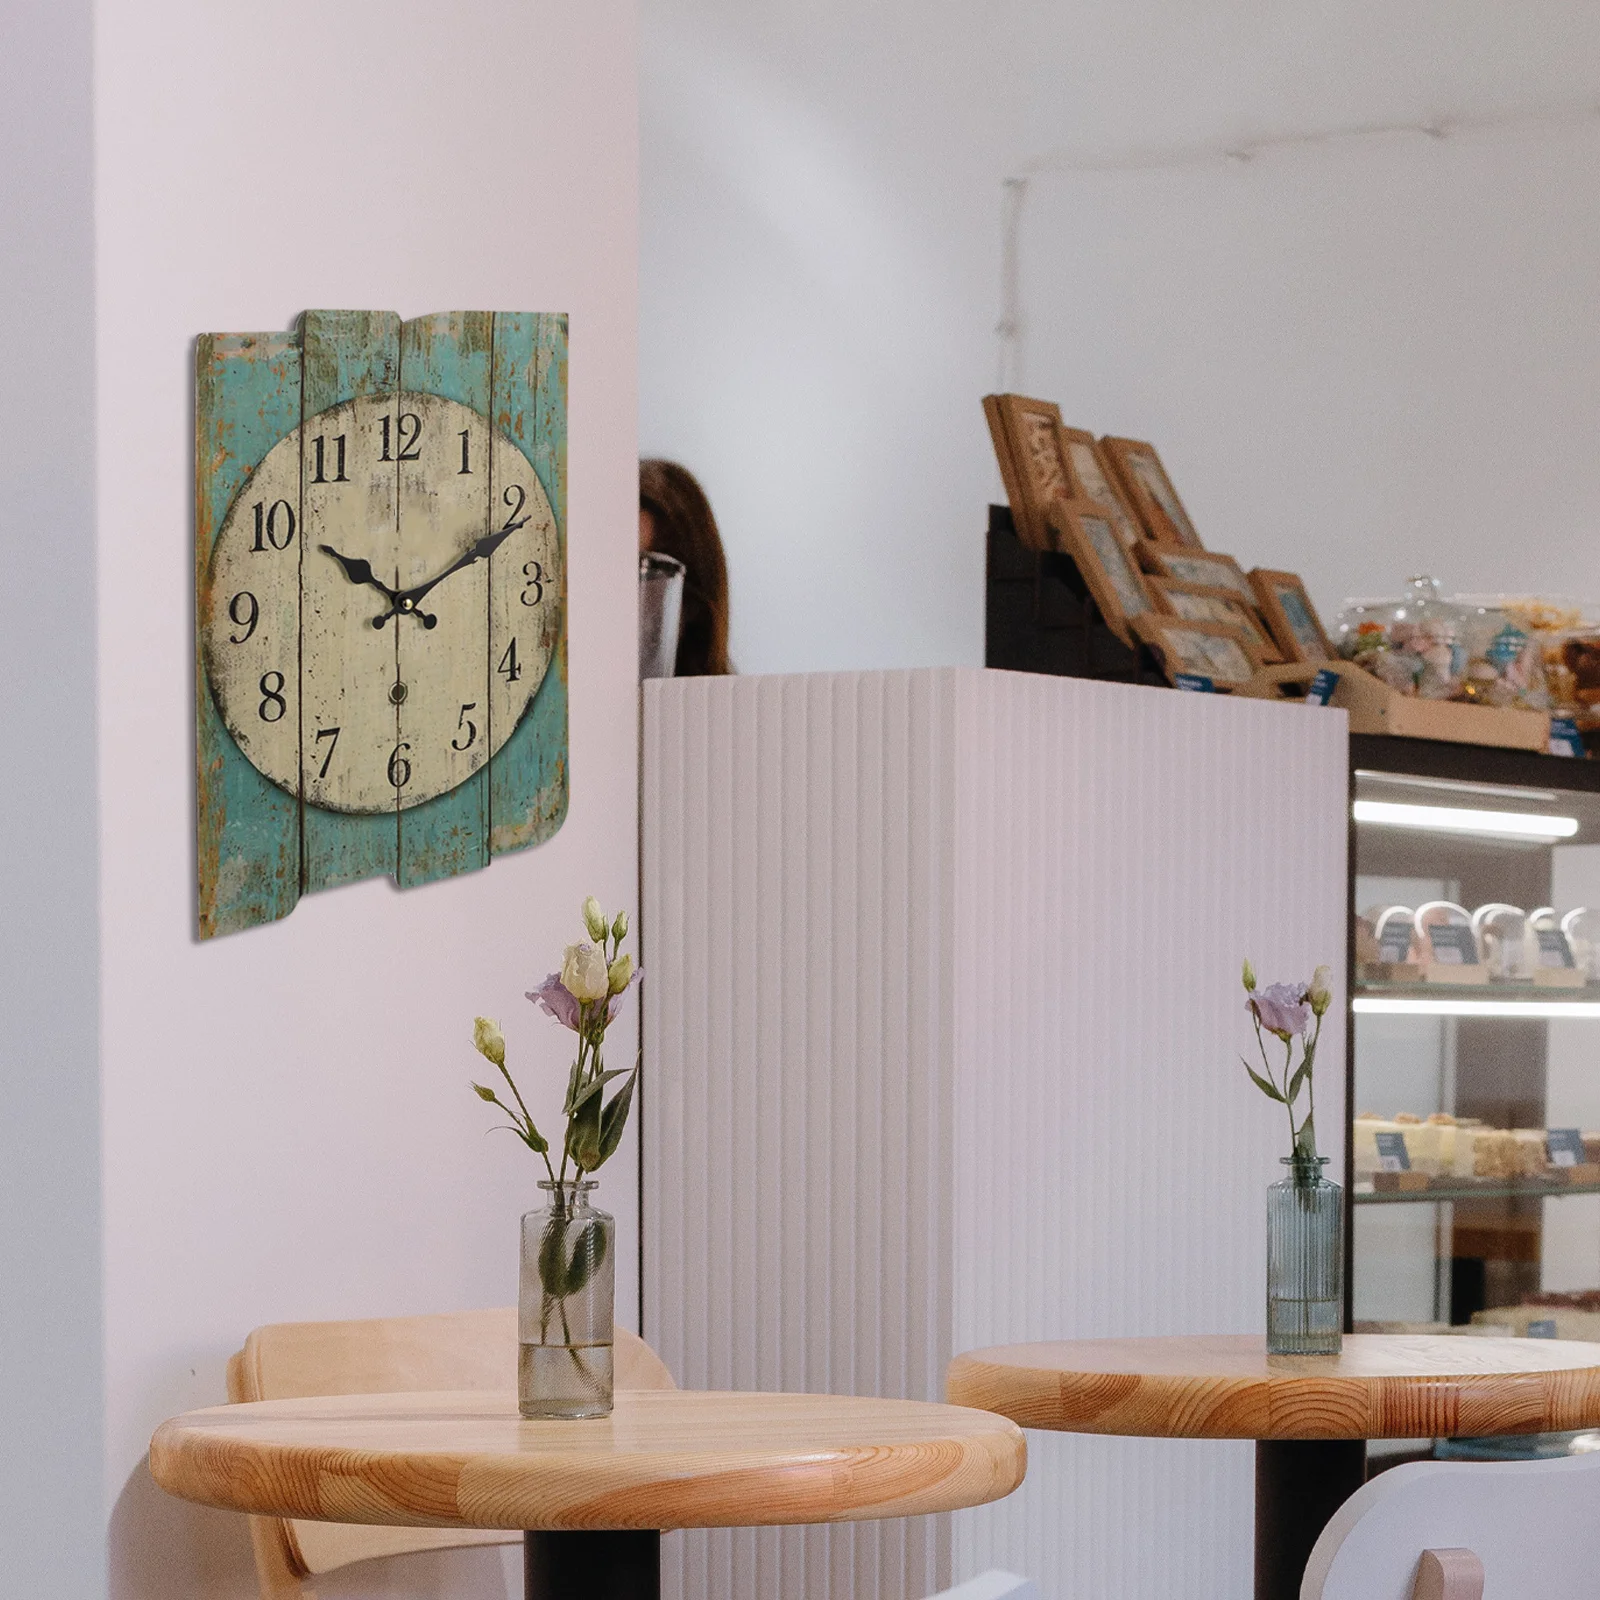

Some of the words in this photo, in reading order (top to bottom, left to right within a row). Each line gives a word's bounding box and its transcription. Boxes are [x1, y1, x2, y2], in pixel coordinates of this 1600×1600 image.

[310, 434, 351, 484] 11
[377, 413, 422, 462] 12
[457, 429, 473, 475] 1
[249, 499, 296, 552] 10
[502, 484, 526, 530] 2
[520, 561, 543, 606] 3
[229, 591, 259, 644] 9
[497, 637, 522, 683] 4
[258, 671, 286, 722] 8
[451, 702, 476, 751] 5
[315, 727, 341, 778] 7
[388, 743, 411, 788] 6
